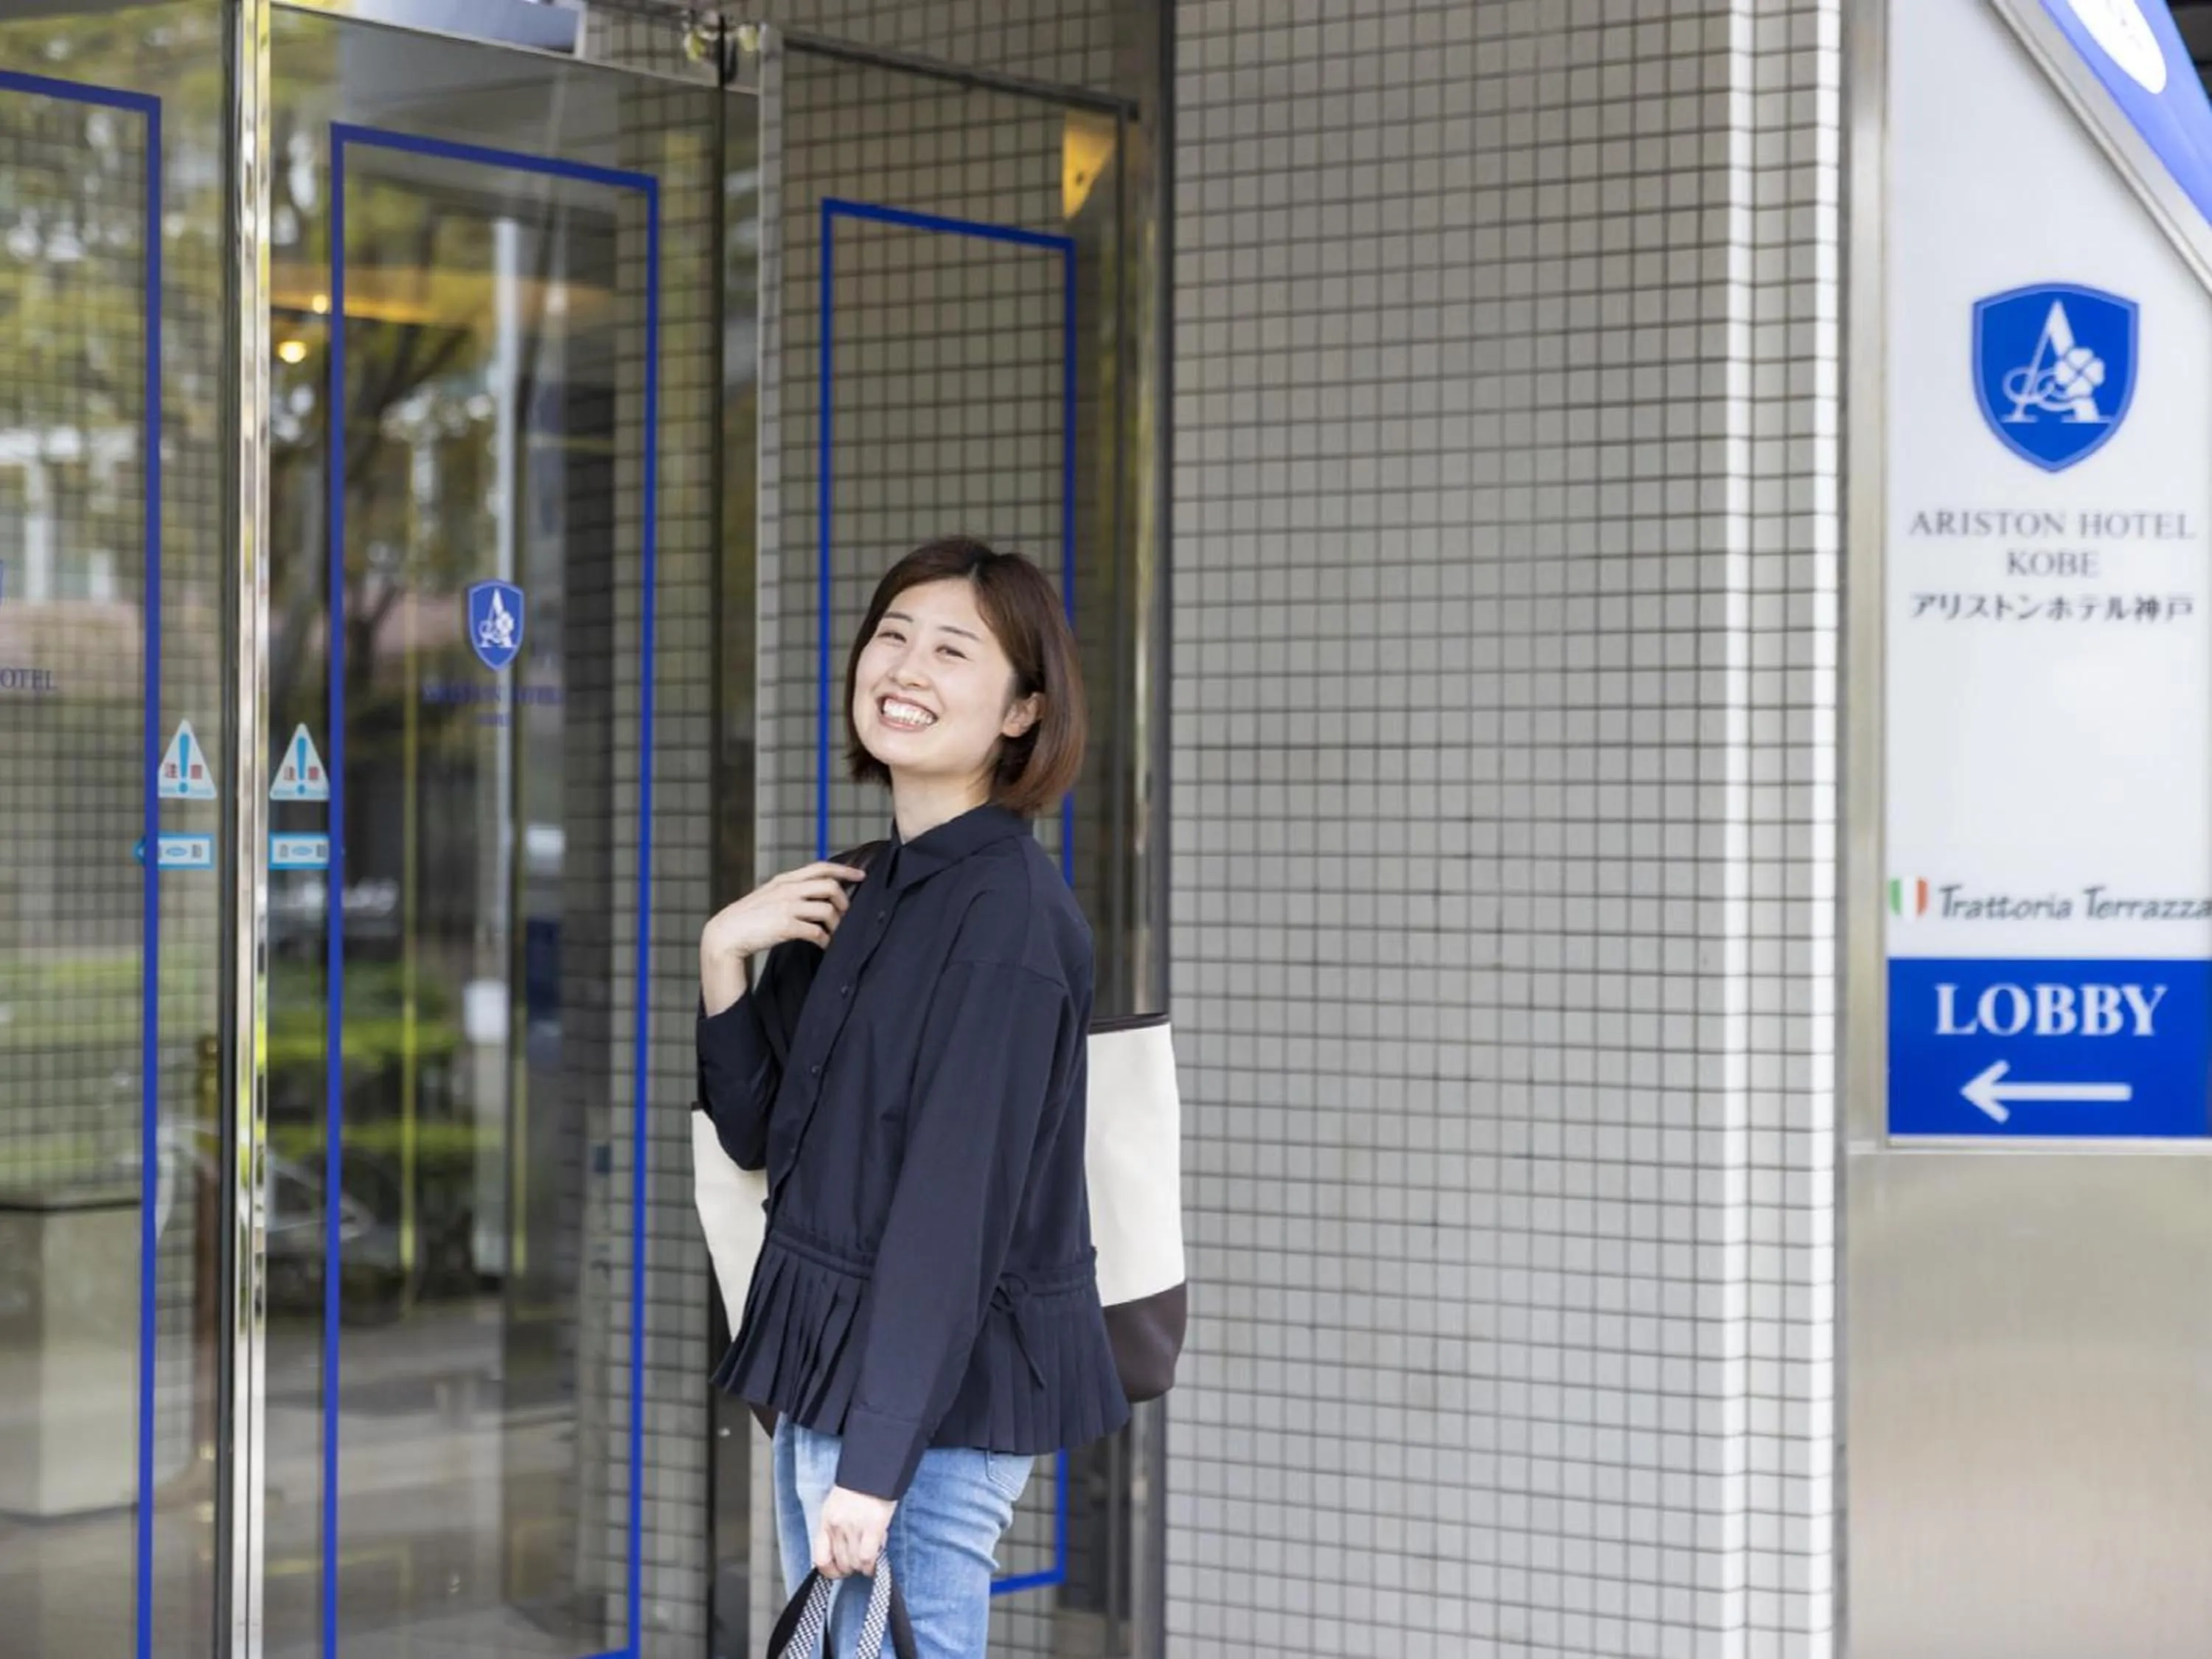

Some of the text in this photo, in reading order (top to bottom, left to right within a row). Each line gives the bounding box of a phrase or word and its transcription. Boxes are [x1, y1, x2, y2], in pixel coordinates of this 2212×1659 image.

[1909, 511, 2197, 538] ARISTON HOTEL
[2006, 550, 2101, 577] KOBE
[1911, 591, 2194, 622] アリストンホテル神戸
[1938, 884, 2212, 919] Trattoria Terrazza
[1934, 982, 2168, 1035] LOBBY
